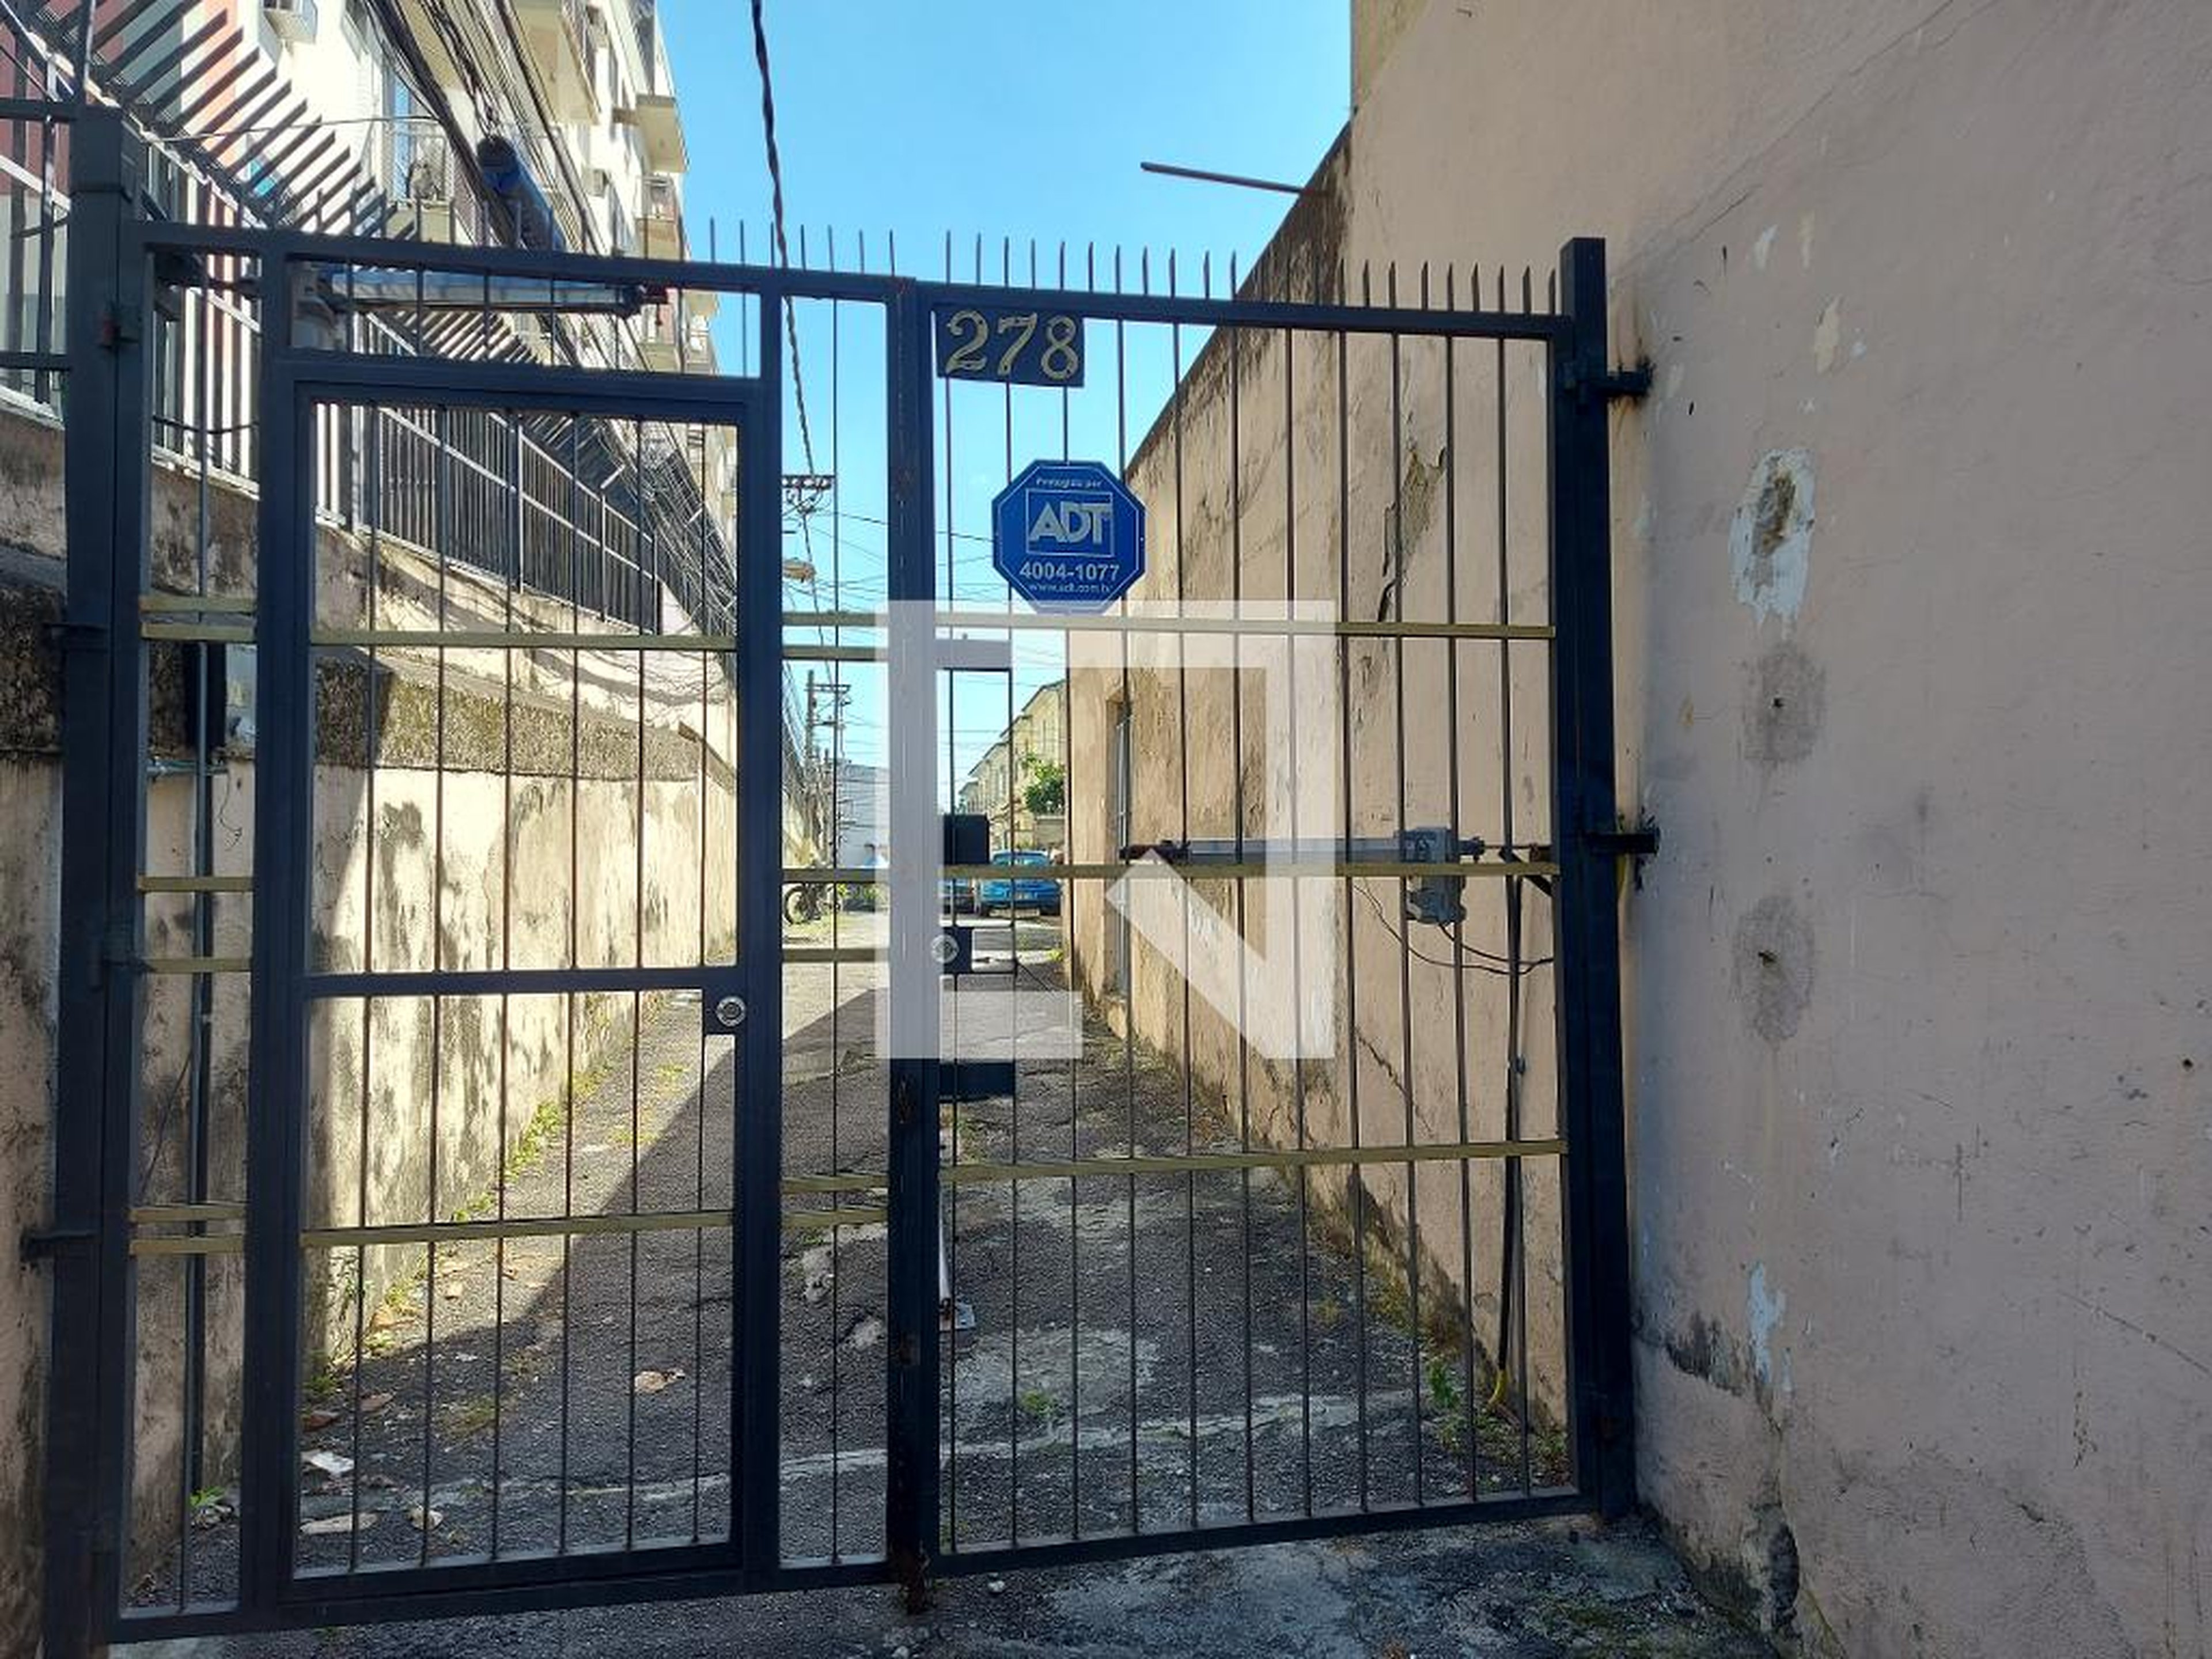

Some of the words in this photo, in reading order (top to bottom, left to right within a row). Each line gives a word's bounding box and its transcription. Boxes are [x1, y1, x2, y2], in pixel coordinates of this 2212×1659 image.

[945, 309, 1079, 380] 278
[1029, 501, 1113, 545] ADT
[1019, 561, 1120, 581] 4004-1077
